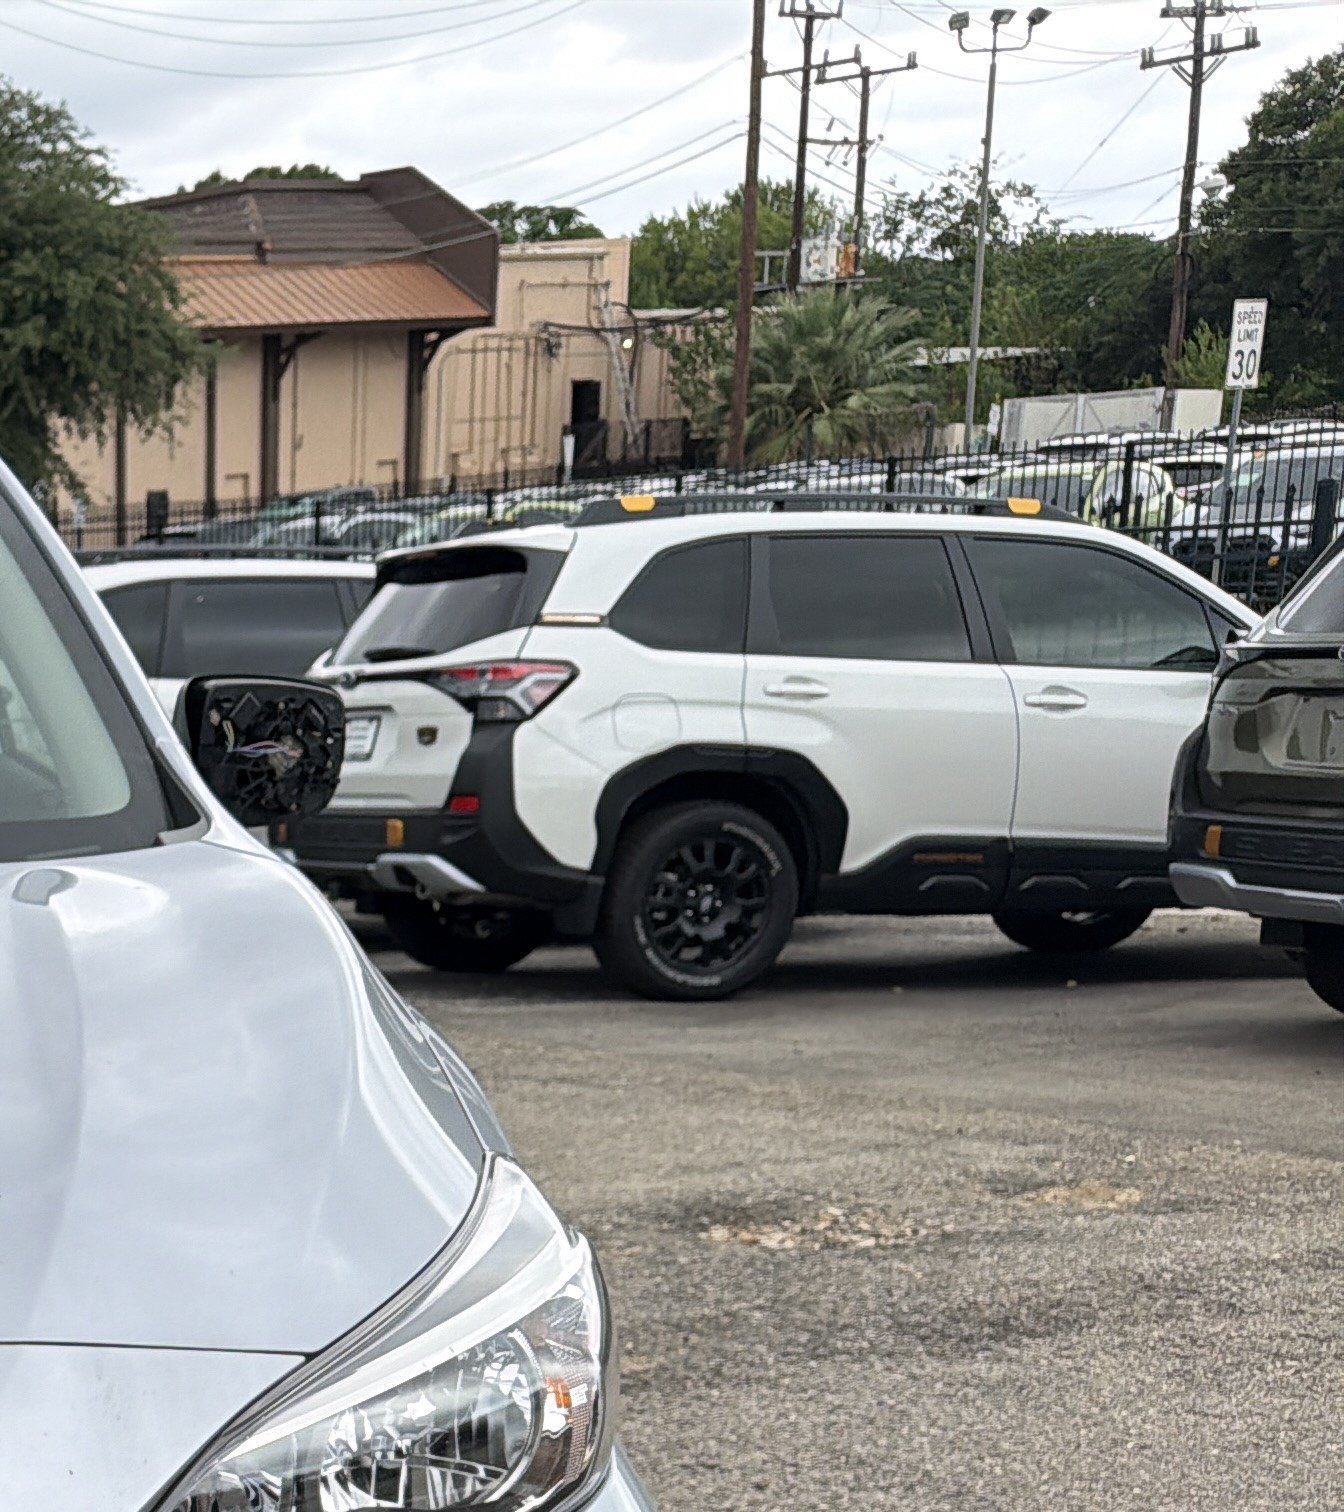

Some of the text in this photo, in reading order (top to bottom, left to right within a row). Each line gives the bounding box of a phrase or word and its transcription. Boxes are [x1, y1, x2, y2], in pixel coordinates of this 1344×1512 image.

[1237, 310, 1263, 325] SPEED
[1237, 328, 1259, 342] LIMIT
[1232, 349, 1257, 380] 30
